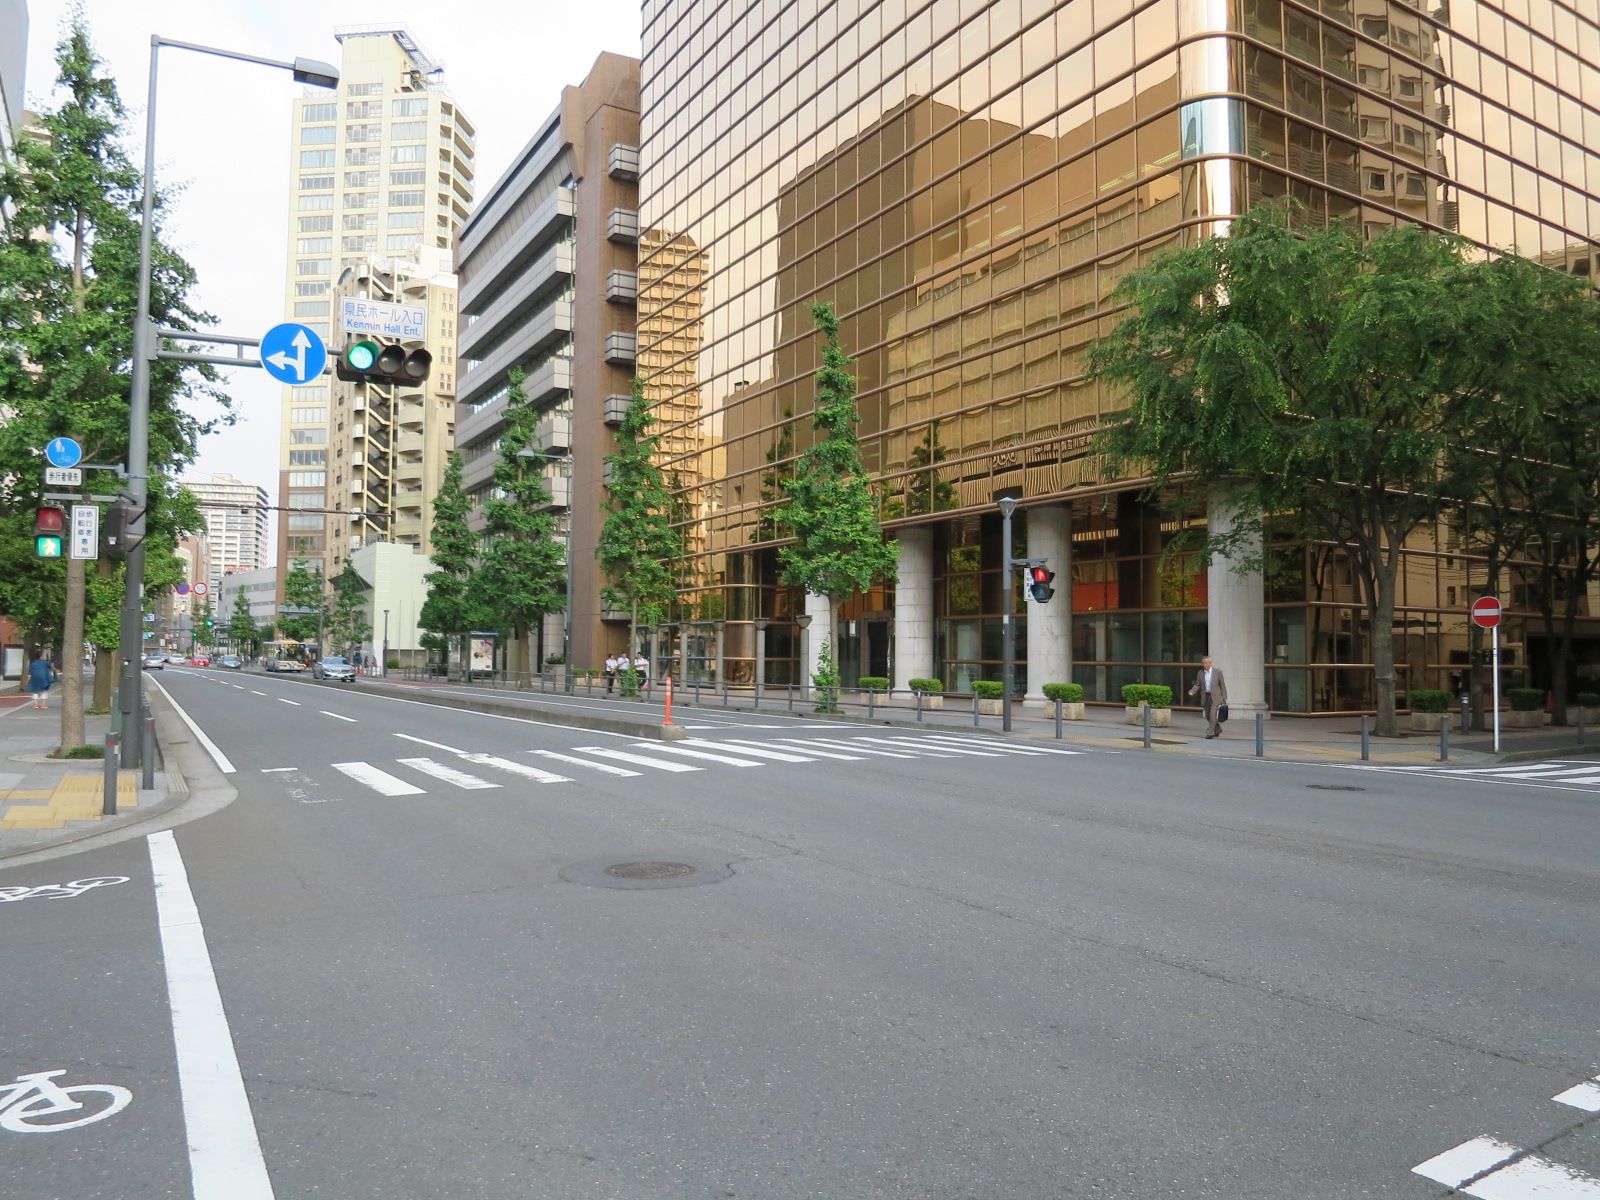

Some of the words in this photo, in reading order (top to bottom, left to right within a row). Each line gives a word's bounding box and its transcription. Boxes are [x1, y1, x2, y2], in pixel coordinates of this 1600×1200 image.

[345, 302, 423, 325] 県民ホール入口
[346, 319, 381, 331] Kenmin
[384, 324, 401, 333] Hall
[403, 325, 421, 337] Ent.
